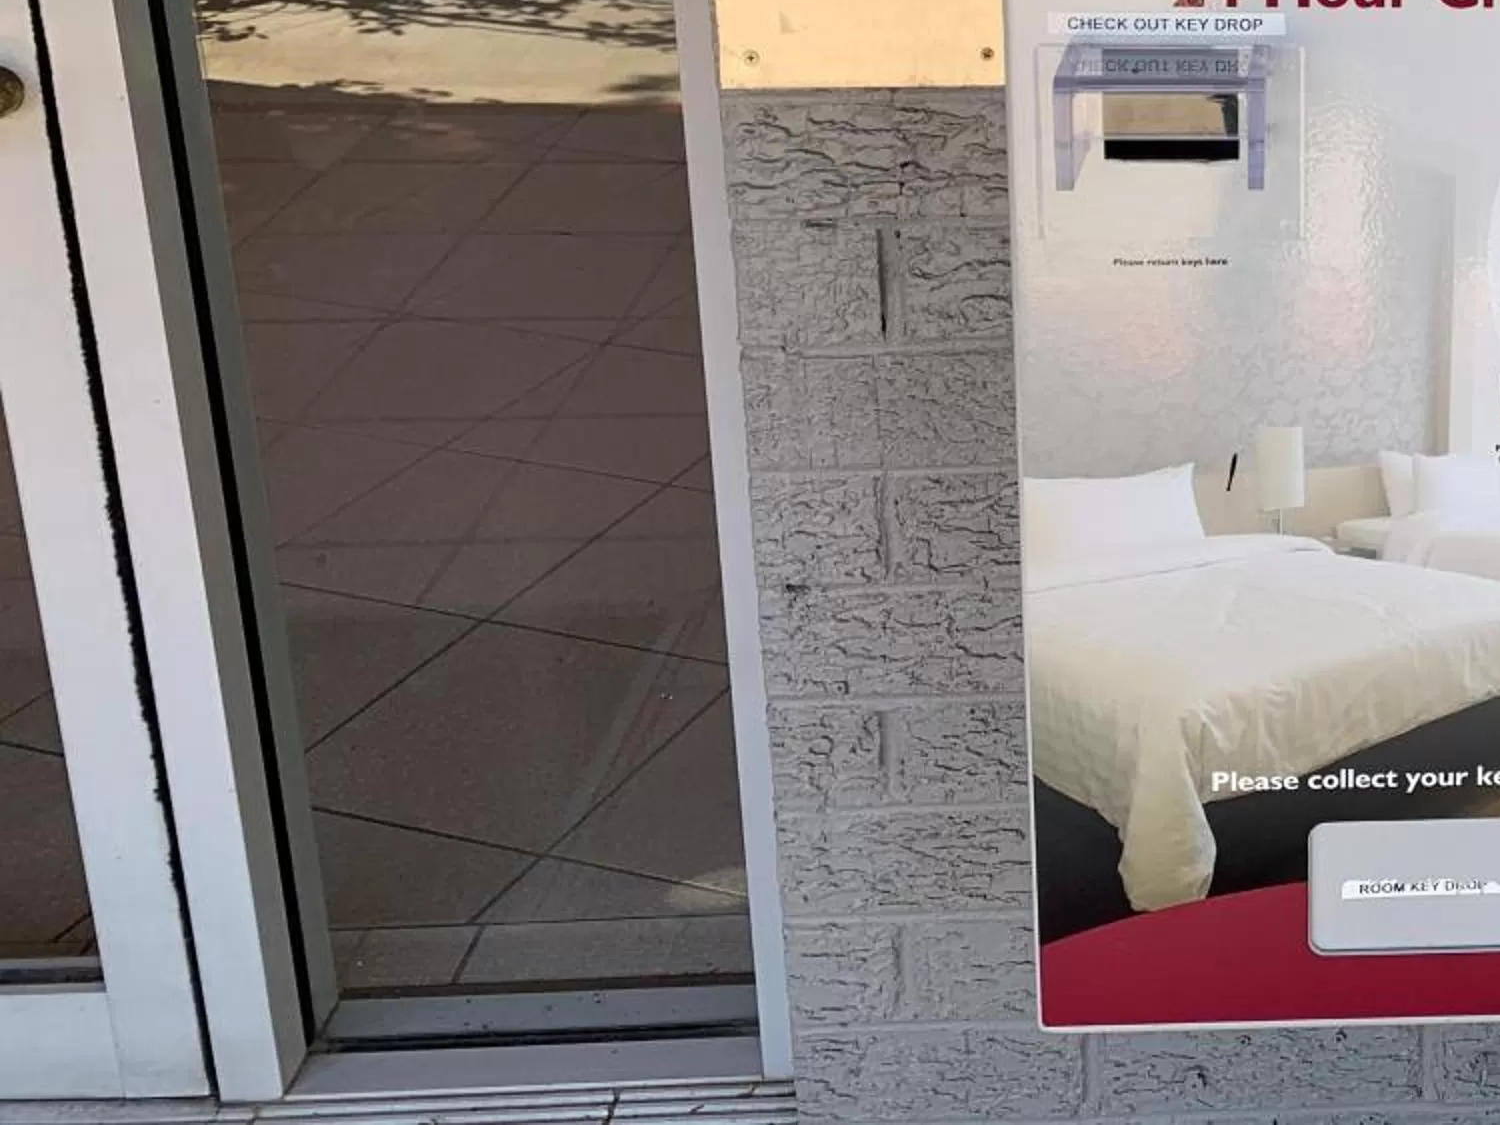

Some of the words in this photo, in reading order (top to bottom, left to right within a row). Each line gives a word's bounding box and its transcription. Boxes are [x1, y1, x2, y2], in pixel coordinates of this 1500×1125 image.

[1067, 17, 1128, 31] CHECK
[1133, 17, 1169, 31] OUT
[1175, 18, 1209, 31] KEY
[1214, 18, 1263, 32] DROP
[1113, 257, 1144, 266] Please
[1181, 257, 1203, 268] keys
[1205, 257, 1229, 266] here
[1211, 771, 1299, 792] Please
[1307, 768, 1397, 790] collect
[1404, 769, 1469, 793] your
[1359, 882, 1406, 895] ROOM
[1410, 881, 1440, 892] KEY
